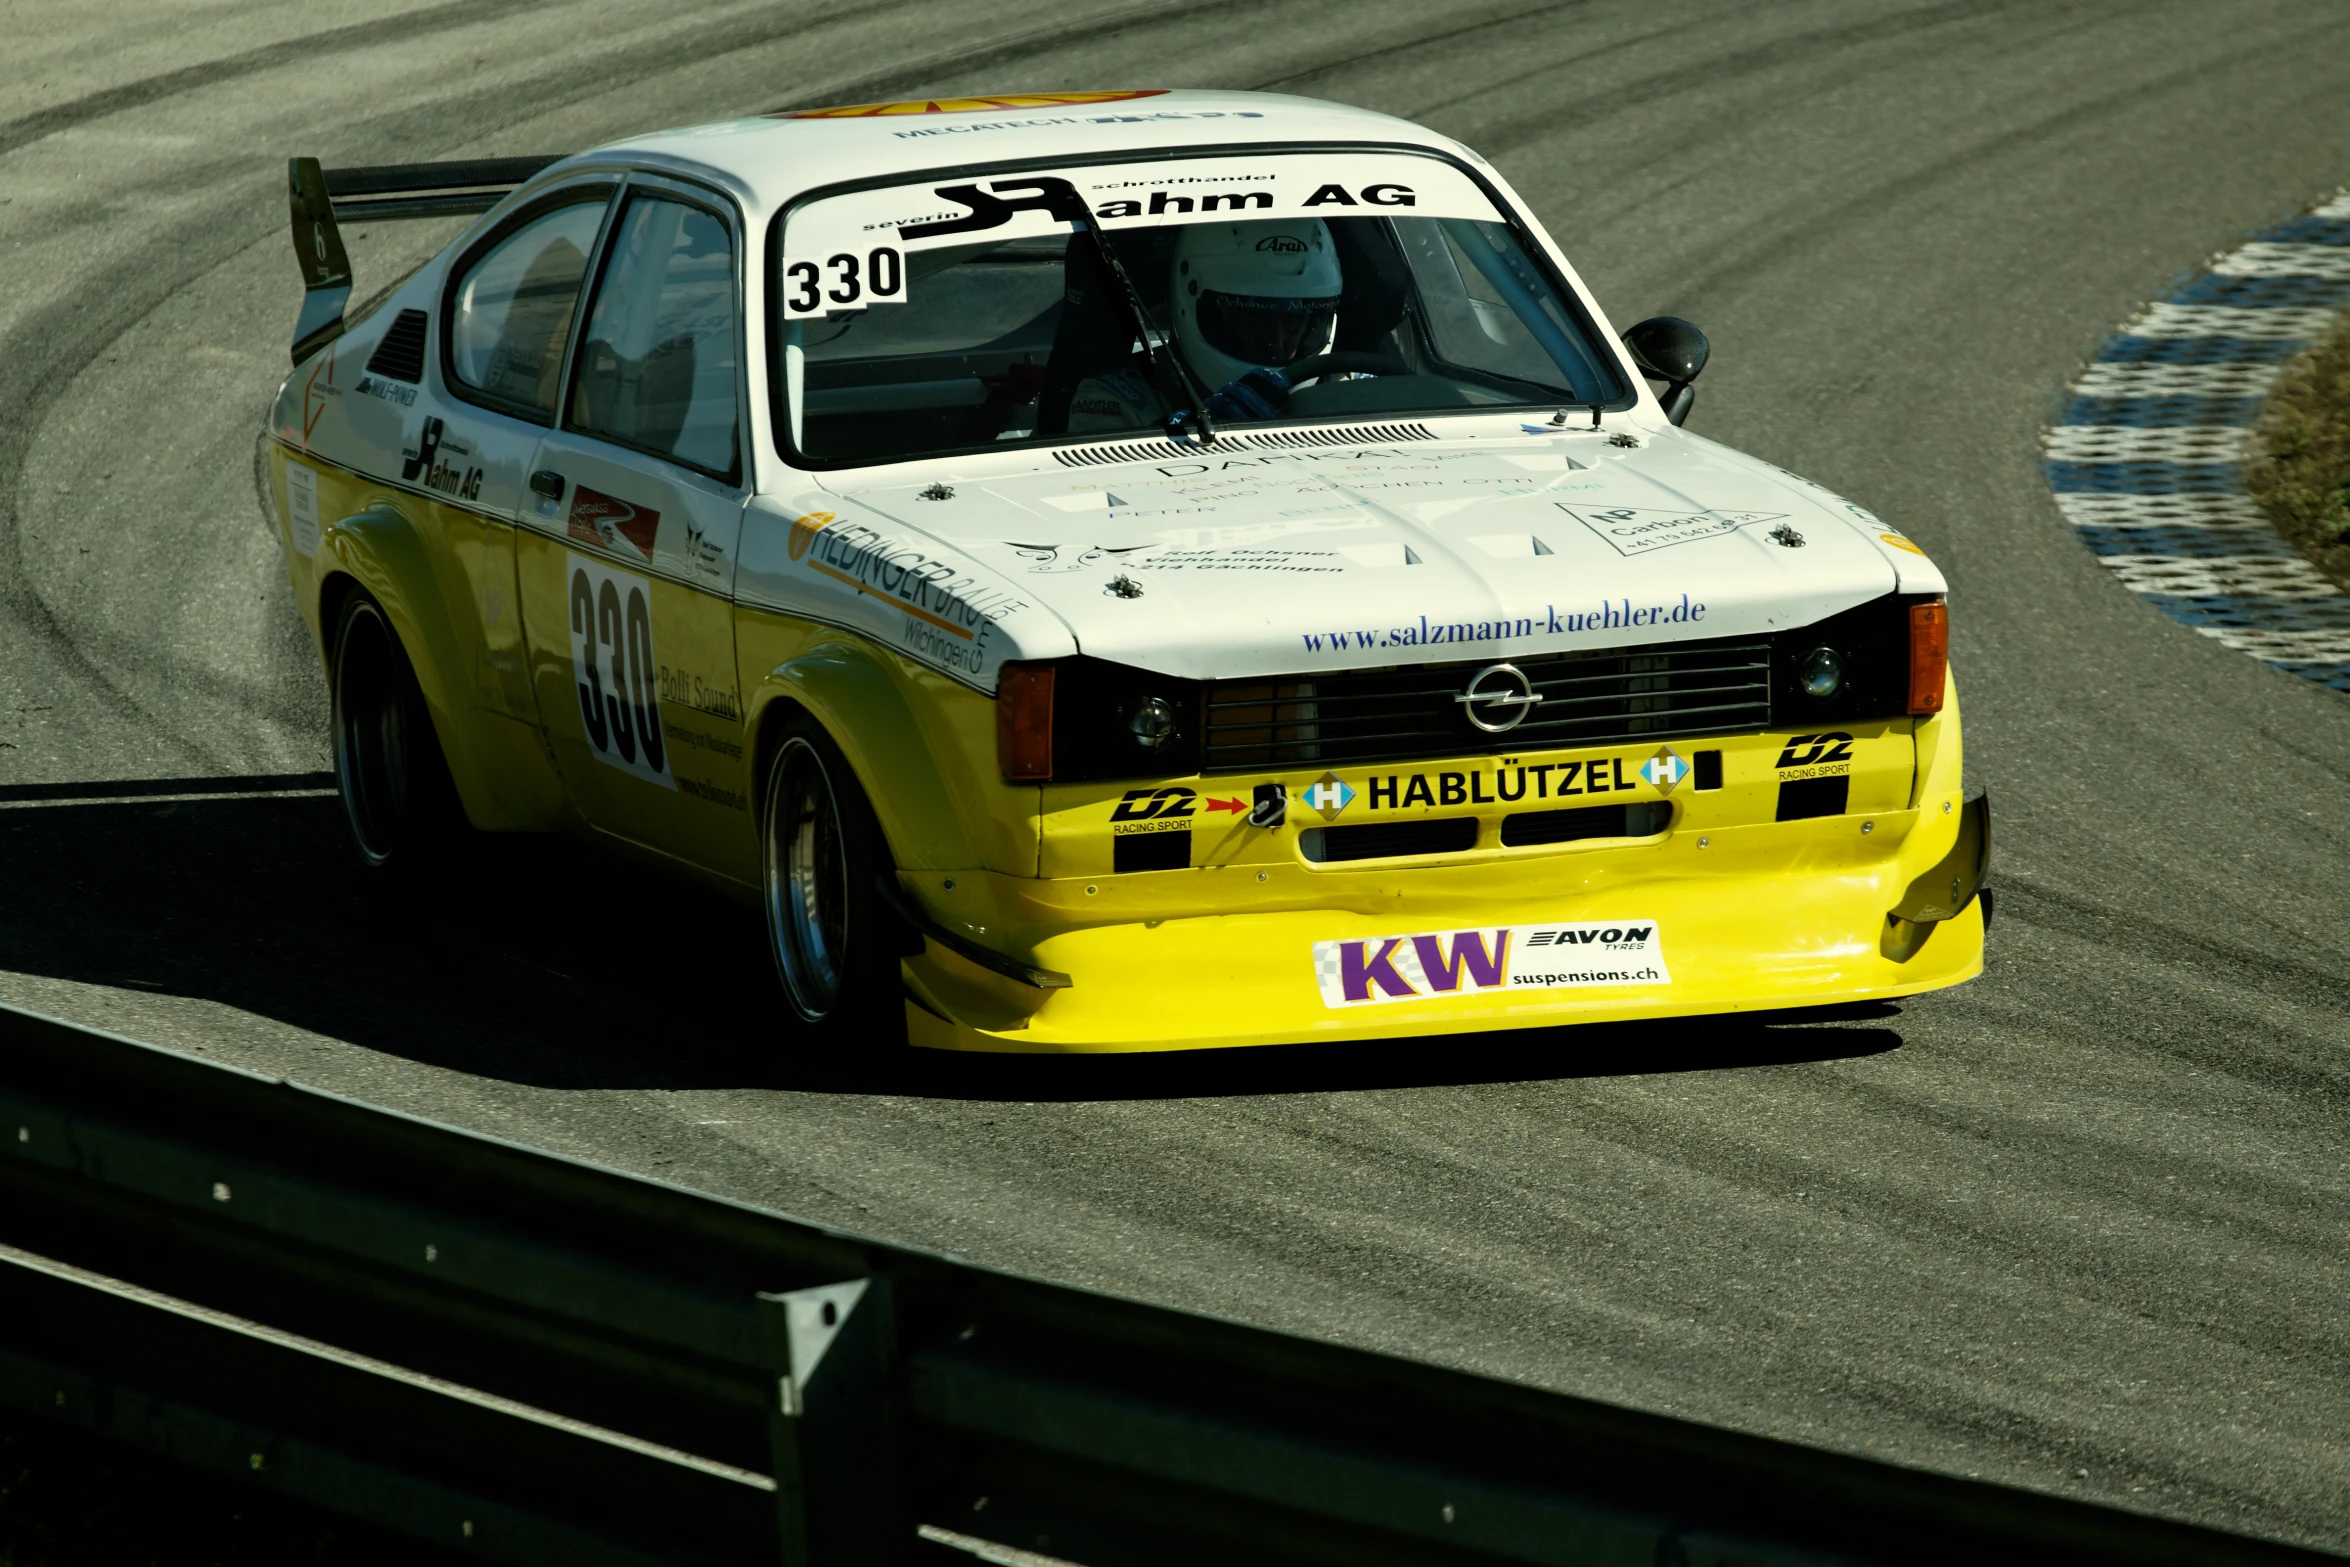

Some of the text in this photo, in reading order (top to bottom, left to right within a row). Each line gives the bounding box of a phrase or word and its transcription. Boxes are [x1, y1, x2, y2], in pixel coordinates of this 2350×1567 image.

[891, 117, 1077, 139] MECATECH
[1091, 174, 1276, 189] schrotthandel
[1302, 183, 1416, 207] AG
[862, 210, 959, 232] severin
[1261, 237, 1303, 253] Arai
[787, 246, 901, 313] 330
[459, 466, 484, 501] AG
[1070, 478, 1208, 491] MATTHIS
[1190, 490, 1258, 503] PINO
[1109, 507, 1216, 519] PETER
[1589, 509, 1637, 524] NP
[1611, 516, 1709, 537] Carbon
[1627, 538, 1657, 548] +41
[1655, 534, 1680, 542] 79
[1680, 527, 1713, 537] 642
[1231, 549, 1340, 557] Ochsner
[810, 519, 1014, 627] HEDINGER BAU
[1196, 564, 1345, 573] Gächlingen
[1303, 593, 1706, 653] www.salzmann-kuehler.de
[904, 617, 968, 671] Wilchingen
[969, 601, 1030, 675] GmbH
[571, 567, 665, 774] 330
[661, 665, 737, 719] Bolli Sound
[1775, 731, 1854, 769] D2
[1650, 756, 1677, 786] H
[1779, 763, 1851, 780] RACING SPORT
[1369, 757, 1636, 811] HABLÜTZEL
[1110, 787, 1197, 823] D2
[1314, 781, 1342, 810] H
[1114, 819, 1192, 835] RACING SPORT
[1553, 927, 1653, 945] AVON
[1604, 943, 1645, 951] TYRES
[1339, 930, 1513, 1002] KW
[1513, 967, 1659, 986] suspensions.ch
